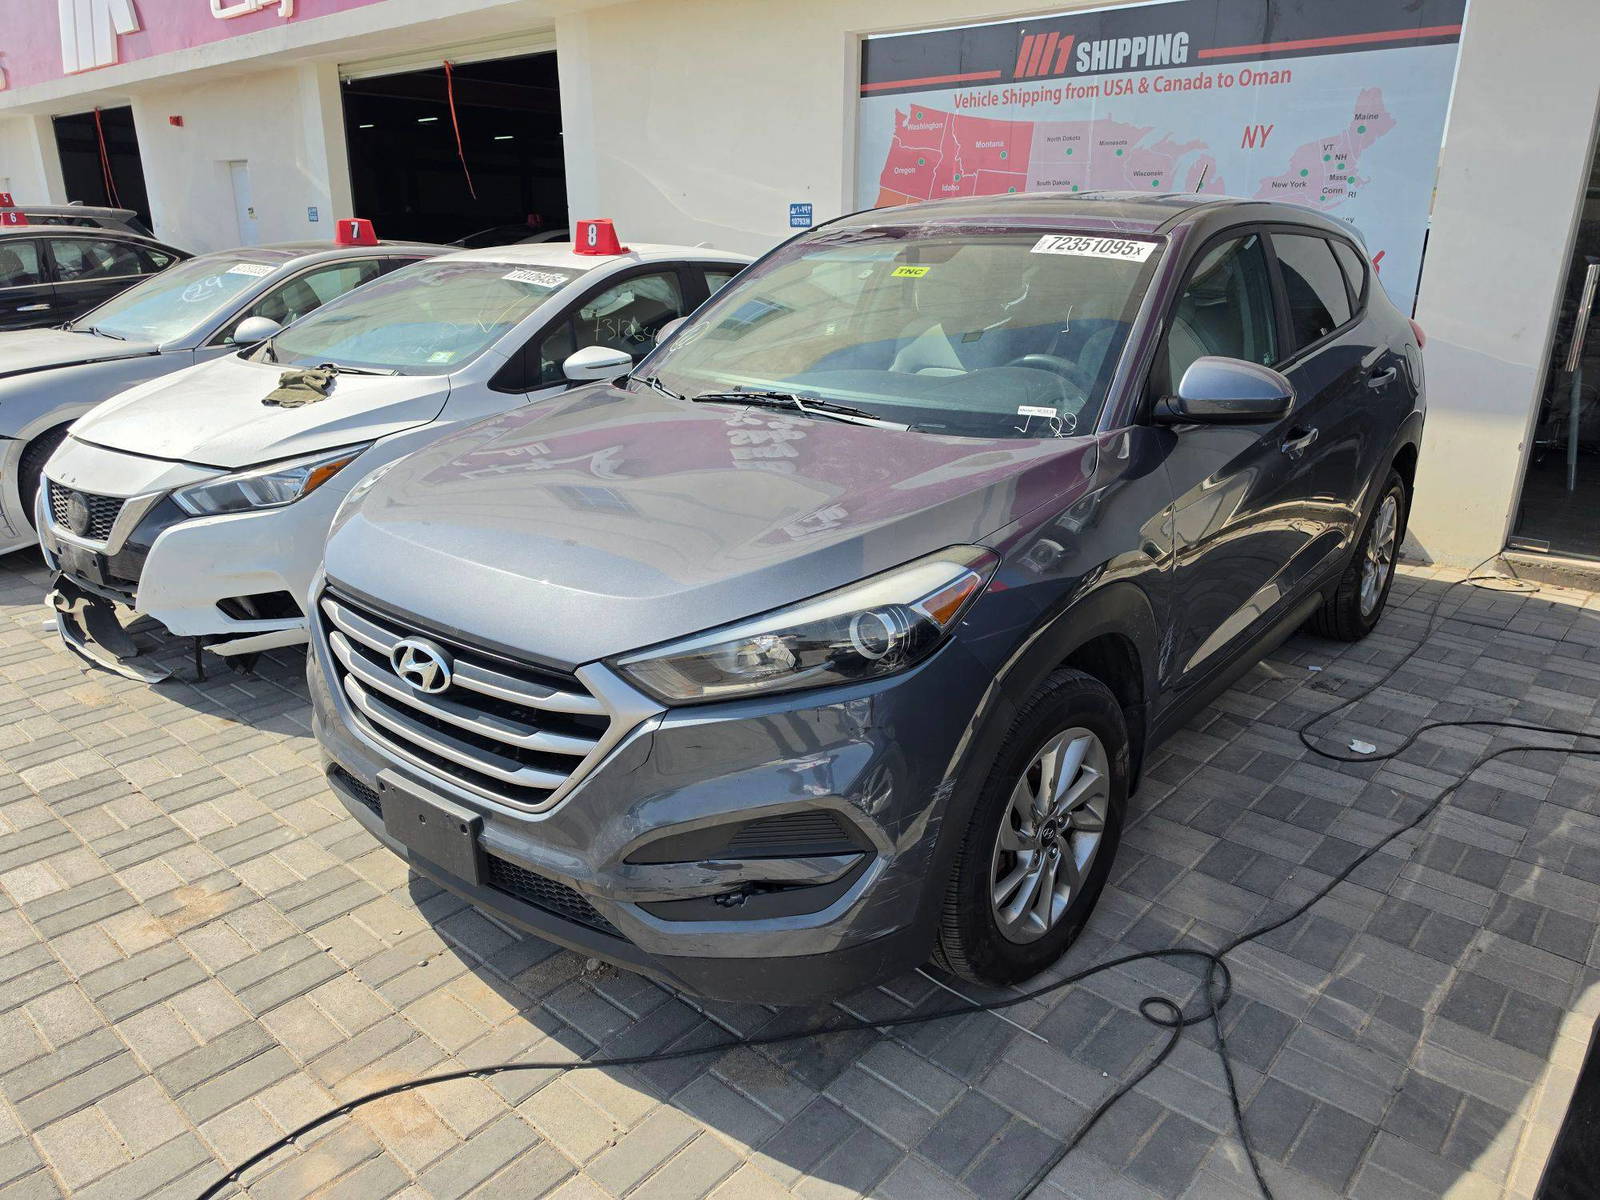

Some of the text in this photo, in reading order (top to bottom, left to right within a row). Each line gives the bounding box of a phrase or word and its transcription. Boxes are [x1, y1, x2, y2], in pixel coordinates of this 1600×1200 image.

[1075, 31, 1190, 72] SHIPPING
[954, 68, 1292, 109] Vehicle Shipping from USA & Canada to Oman
[1354, 113, 1379, 121] Maine
[907, 121, 943, 131] Washington
[1241, 124, 1274, 149] NY
[975, 140, 1004, 148] Montana
[894, 167, 916, 175] Oregon
[942, 184, 960, 192] Idaho
[1289, 180, 1307, 188] York
[10, 212, 17, 223] 6
[350, 221, 360, 239] 7
[587, 223, 597, 247] 8
